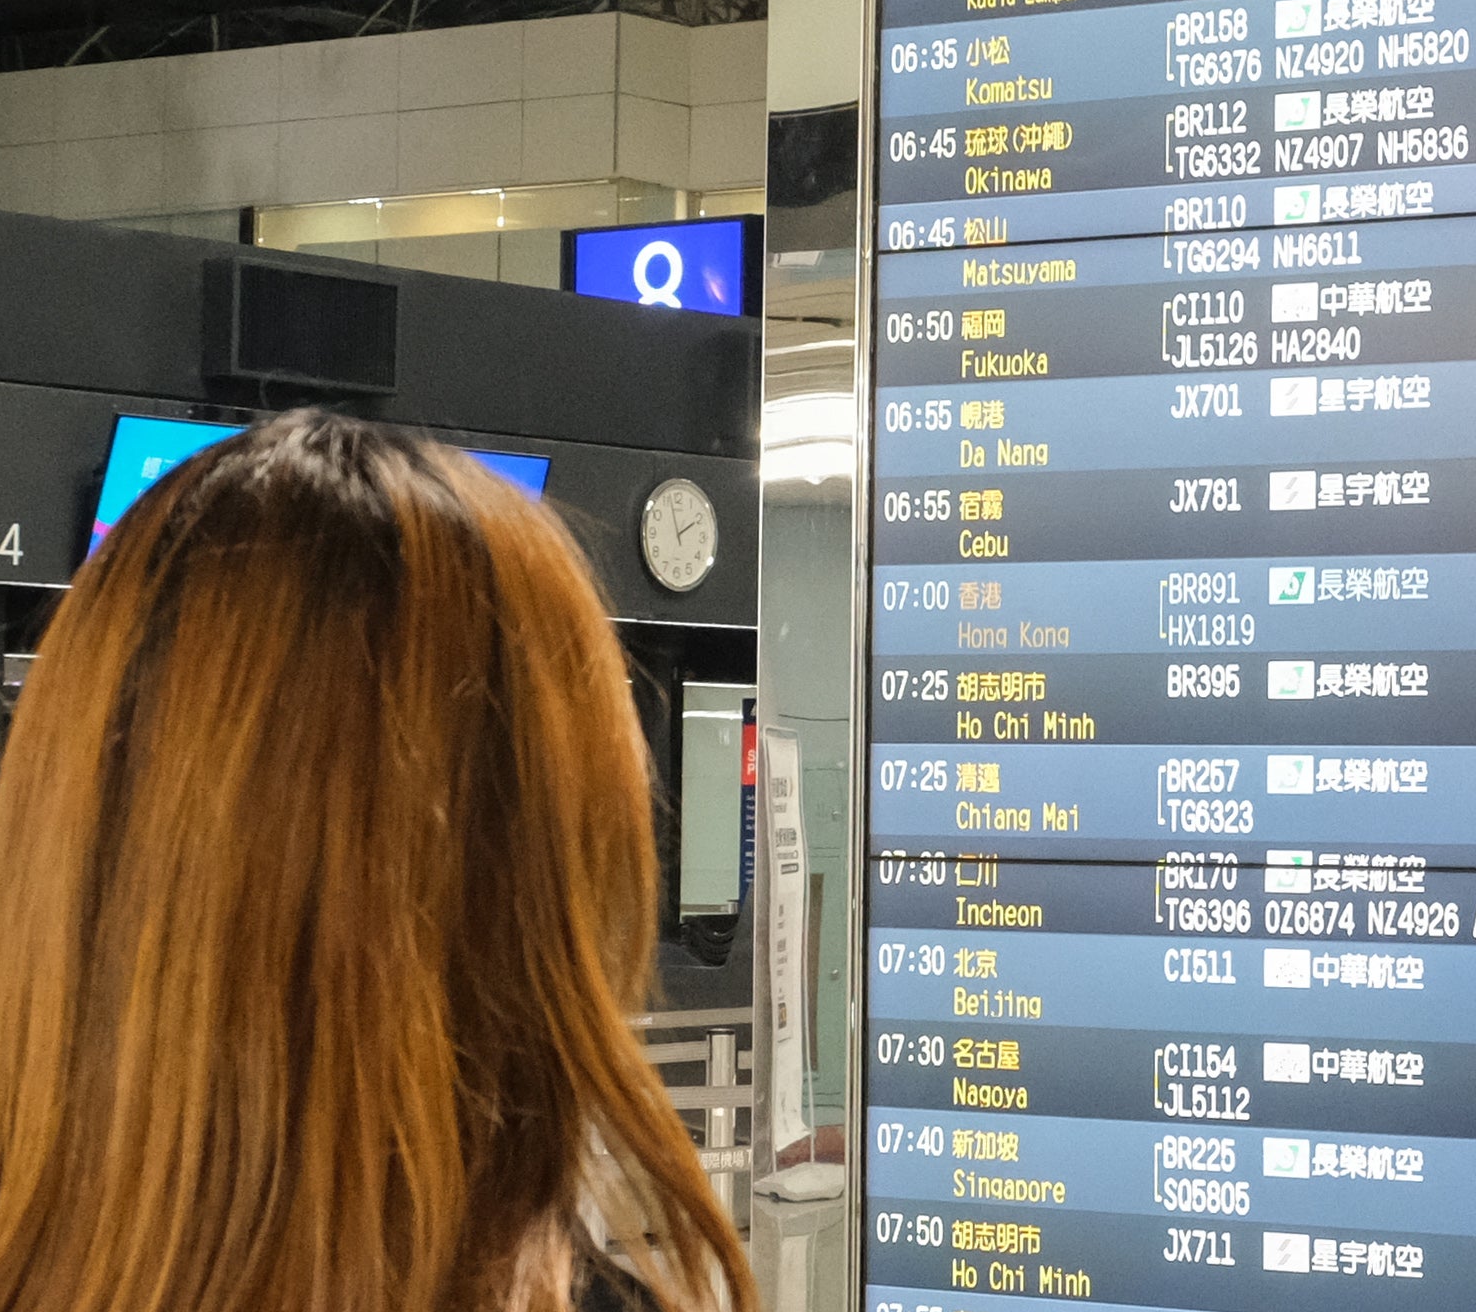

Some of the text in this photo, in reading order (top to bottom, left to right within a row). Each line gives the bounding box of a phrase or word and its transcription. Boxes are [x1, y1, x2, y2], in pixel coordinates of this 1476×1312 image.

[891, 38, 958, 74] 06:35
[966, 75, 1052, 106] Komatsu
[965, 166, 1052, 195] Okinawa
[1273, 230, 1362, 269] NH6611
[963, 259, 1077, 287] Matsuyama
[886, 310, 953, 344] 06:50
[961, 348, 1048, 378] Fukuoka
[960, 438, 1048, 468] Da Nang
[959, 529, 1008, 558] Cebu
[1168, 571, 1240, 605] BR891
[1168, 614, 1255, 647] HX1819
[956, 671, 1046, 702] 胡志明市
[956, 801, 1078, 832] Chiang Mai
[955, 896, 1042, 927] Incheon
[953, 947, 998, 979] 北京
[952, 1038, 1020, 1070] 名古屋
[952, 1128, 1019, 1162] 新加坡
[1311, 1239, 1424, 1278] 星宇航空
